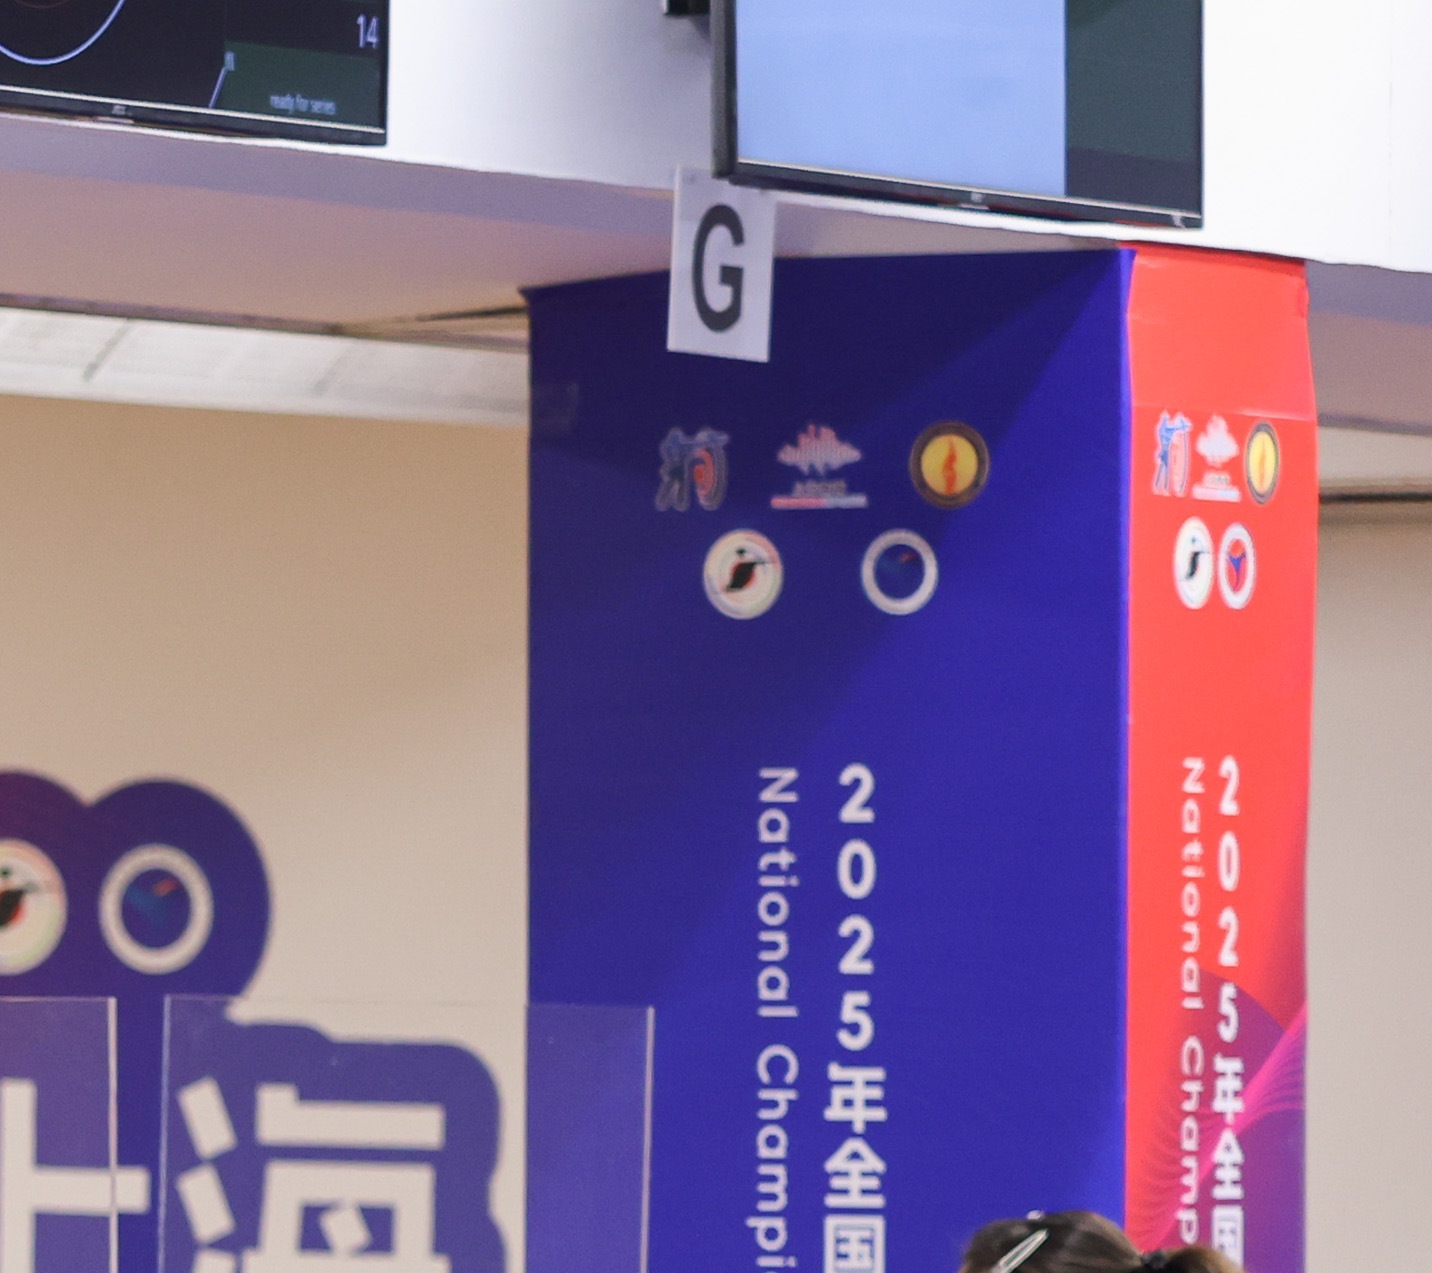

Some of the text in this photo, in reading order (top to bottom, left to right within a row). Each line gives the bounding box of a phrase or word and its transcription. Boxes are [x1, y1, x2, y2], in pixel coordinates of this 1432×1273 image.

[357, 13, 378, 48] 14
[691, 203, 746, 332] G
[757, 767, 800, 1018] National
[1180, 757, 1204, 1010] National
